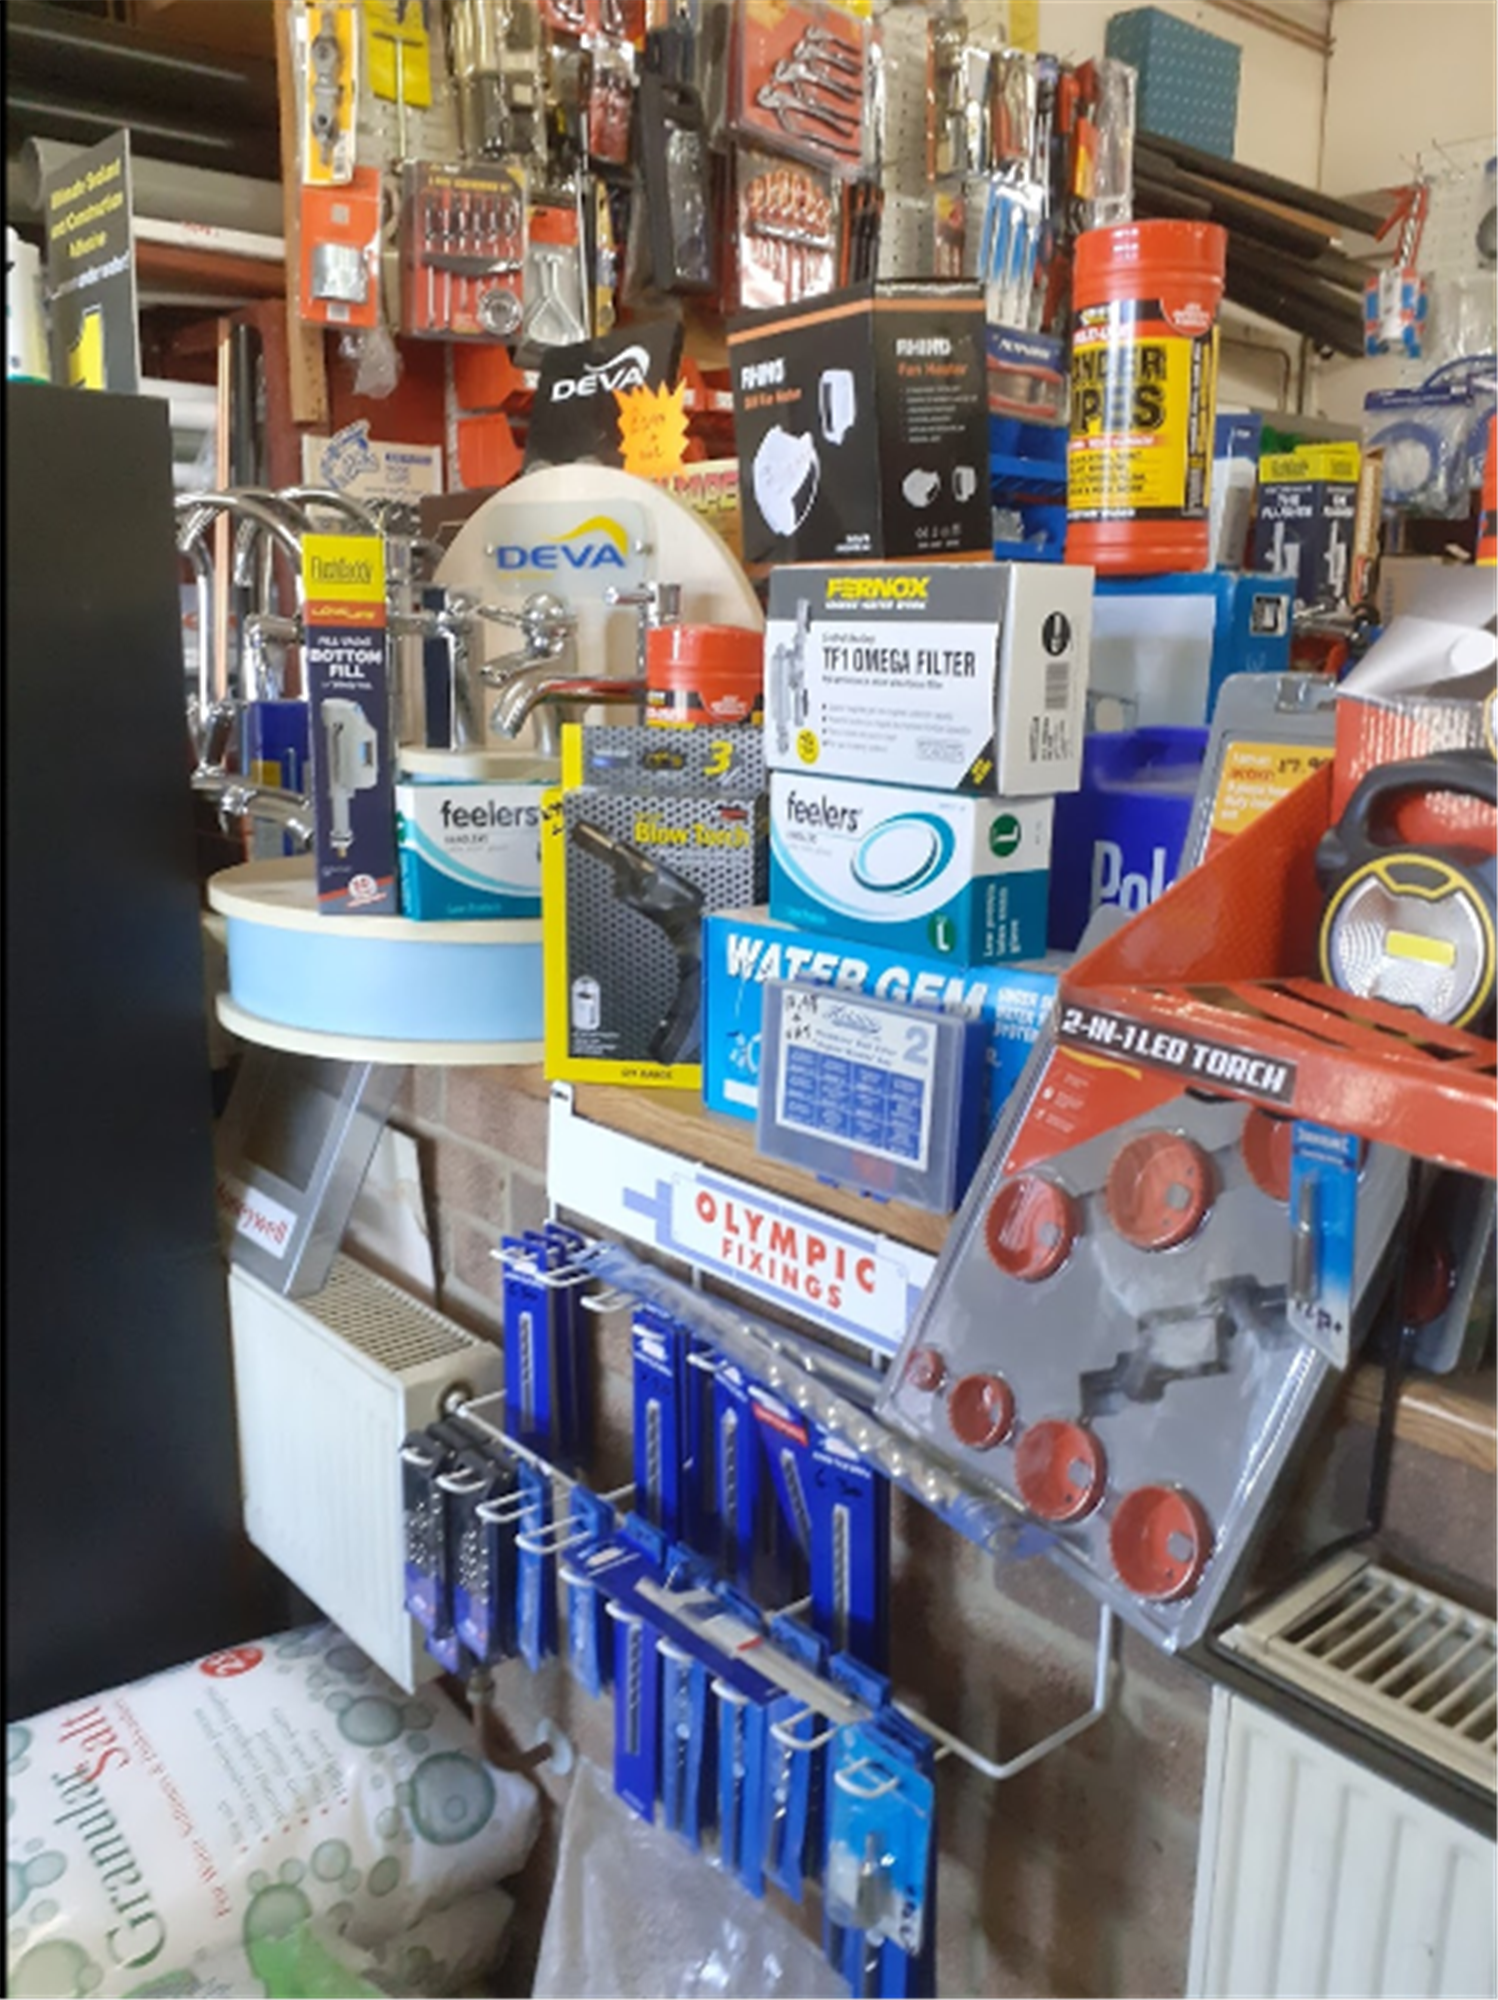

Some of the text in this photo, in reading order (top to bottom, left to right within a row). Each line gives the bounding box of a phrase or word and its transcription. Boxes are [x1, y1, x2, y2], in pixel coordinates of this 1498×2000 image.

[550, 366, 645, 402] DEVA
[898, 362, 922, 376] Fan
[496, 544, 627, 570] DEVA
[826, 576, 930, 599] FERNOX
[311, 648, 382, 665] BOTTOM
[328, 664, 365, 679] FILL
[822, 646, 976, 678] TF1 OMEGA FILTER
[704, 740, 734, 776] 3
[440, 799, 539, 829] feelers
[787, 790, 859, 832] feelers
[634, 818, 750, 847] Blow Torch
[726, 933, 870, 996] WATER
[874, 966, 989, 1019] GEM
[903, 1025, 930, 1067] 2
[1061, 1009, 1288, 1093] 2-IN-1 LED TORCH
[696, 1191, 876, 1294] OLYMPIC
[722, 1236, 842, 1310] FIXINGS
[58, 1705, 130, 1783] Salt
[52, 1767, 166, 1969] Granular
